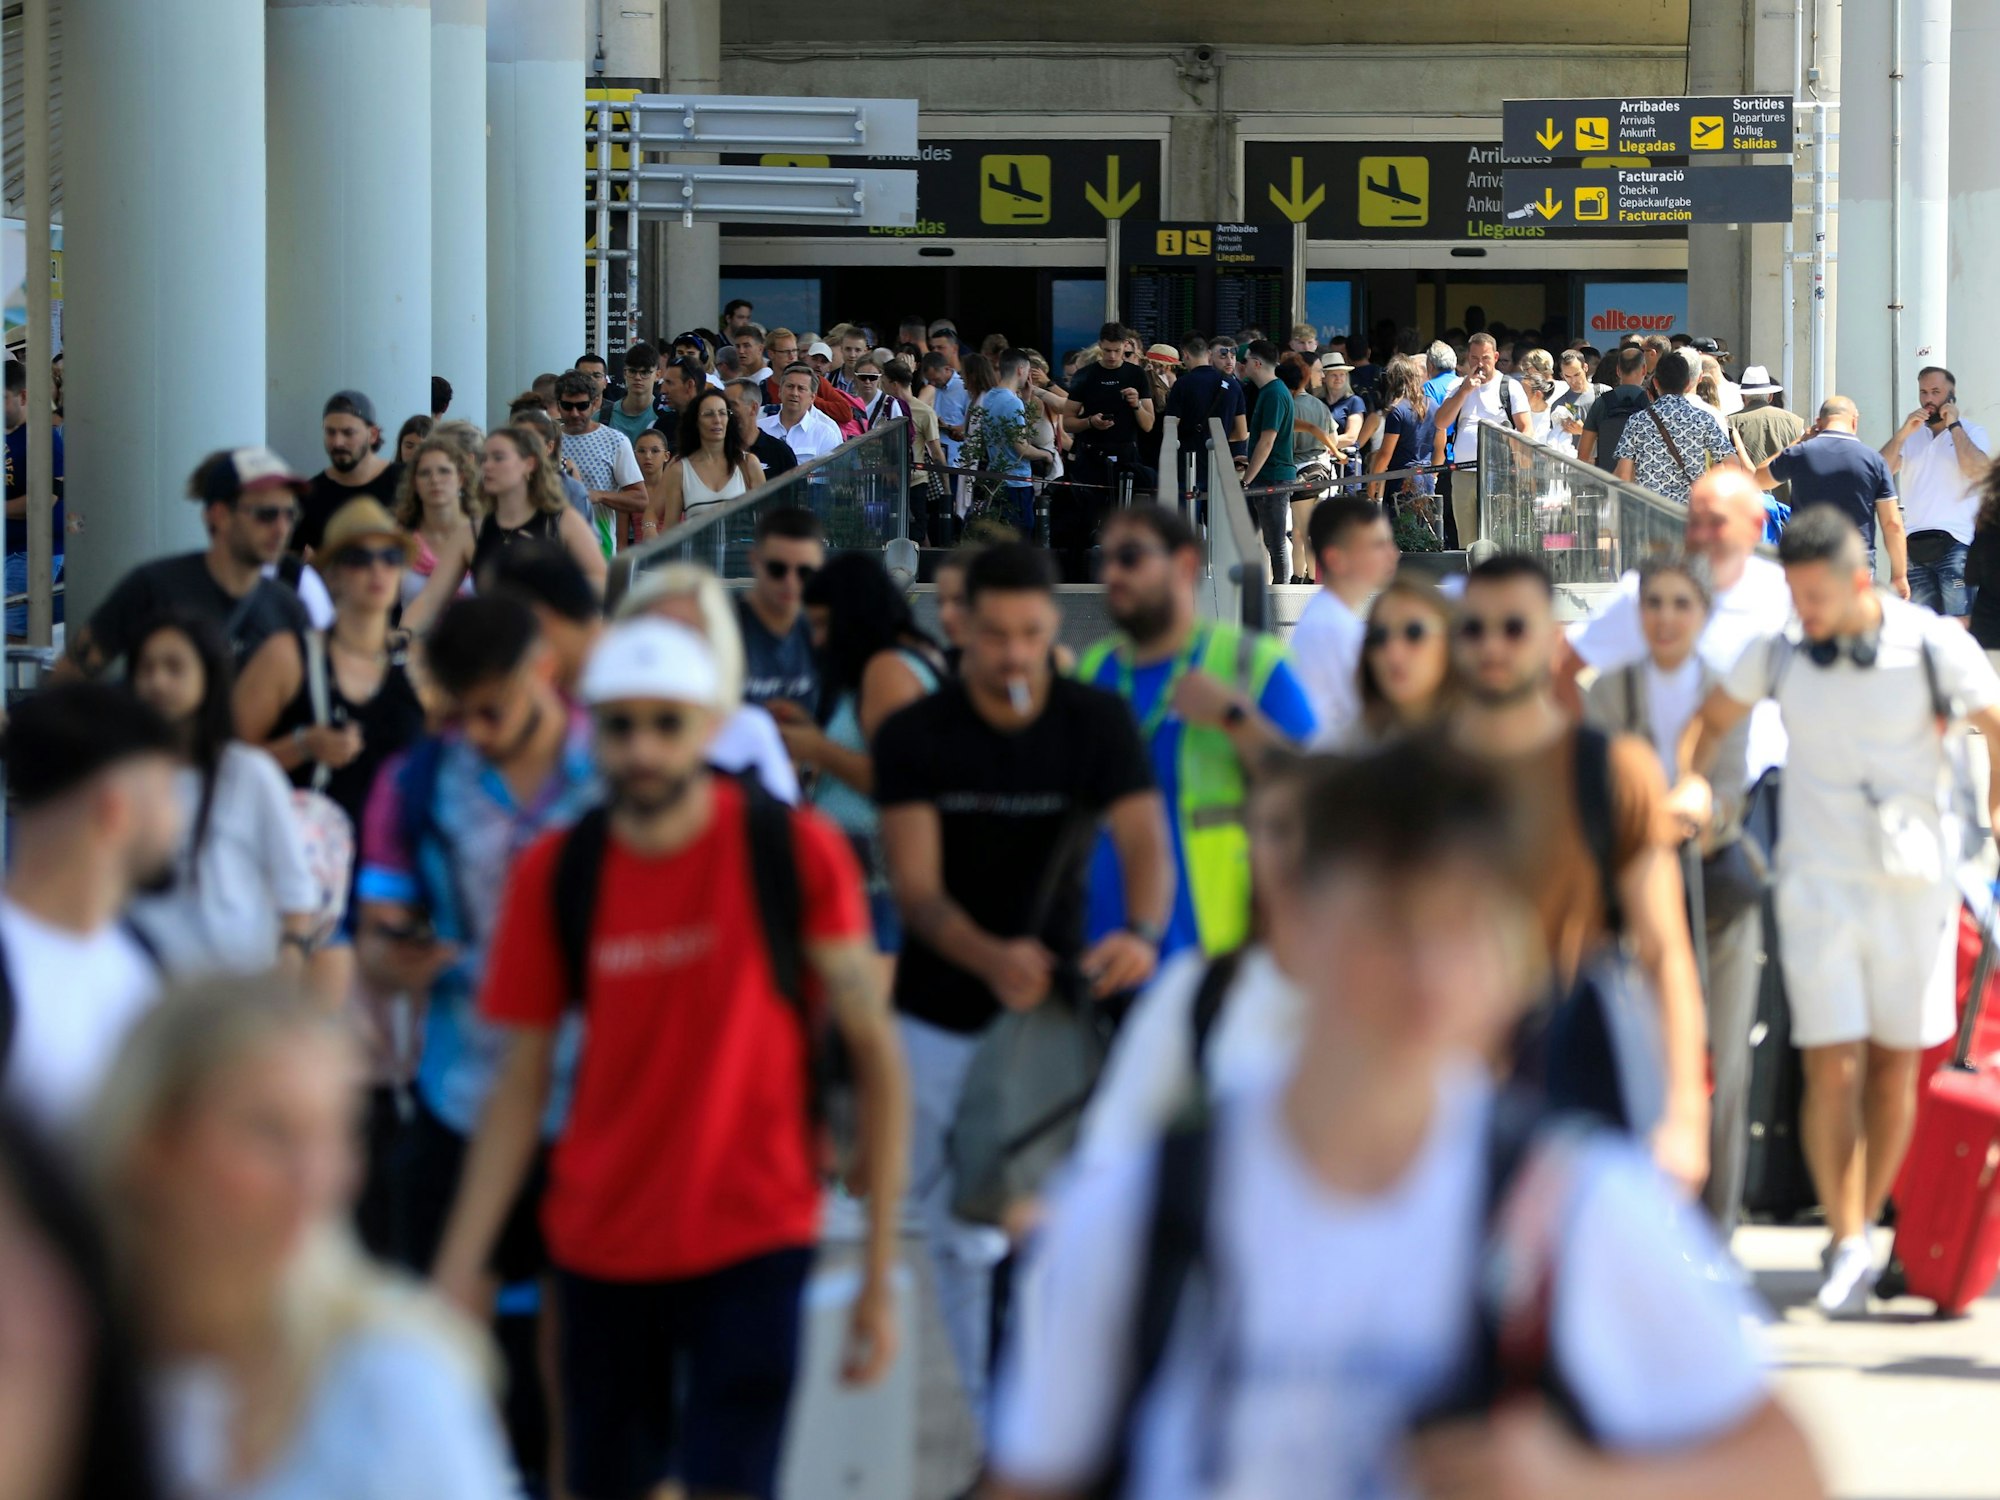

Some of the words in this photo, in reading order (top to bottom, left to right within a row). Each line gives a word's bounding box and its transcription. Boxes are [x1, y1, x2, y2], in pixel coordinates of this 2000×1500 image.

[1619, 101, 1680, 113] Arribades
[1733, 98, 1785, 110] Sortides
[1619, 115, 1656, 126] Arrivals
[1733, 112, 1786, 124] Departures
[1619, 127, 1657, 138] Ankunft
[1733, 125, 1763, 137] Abflug
[1619, 140, 1676, 154] Llegadas
[1733, 137, 1778, 150] Salidas
[1467, 171, 1503, 188] Arriv
[1618, 170, 1685, 183] Facturació
[1619, 185, 1659, 195] Check-in
[1467, 196, 1503, 213] Anku
[1619, 197, 1692, 209] Gepäckaufgabe
[1619, 209, 1692, 221] Facturación
[1216, 224, 1259, 233] Arribades
[1216, 253, 1256, 263] Llegadas
[1591, 309, 1676, 332] alltours
